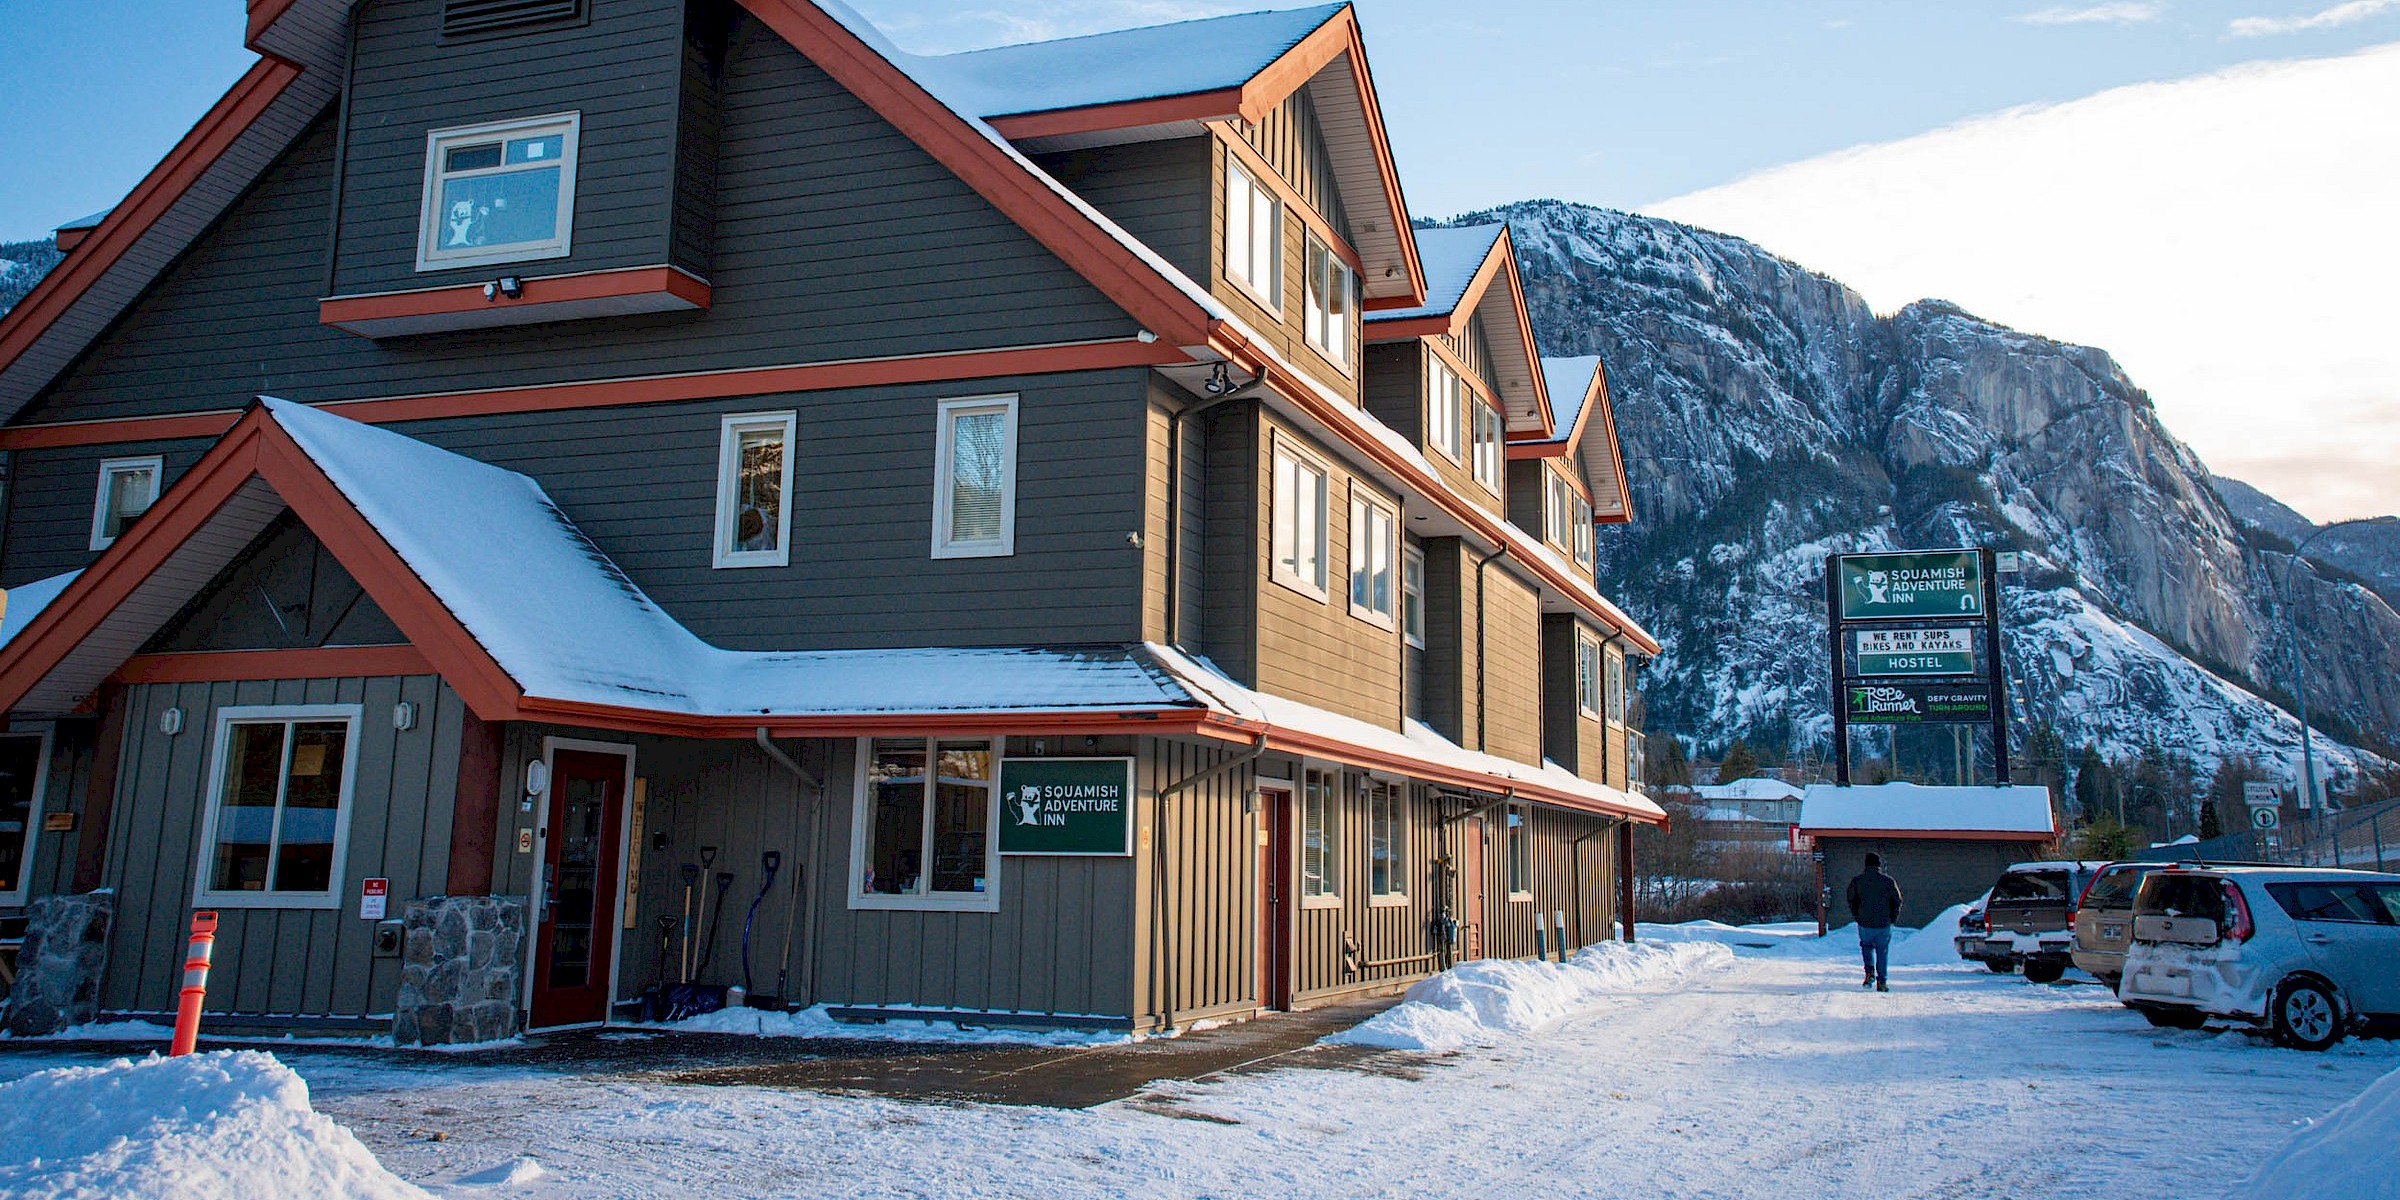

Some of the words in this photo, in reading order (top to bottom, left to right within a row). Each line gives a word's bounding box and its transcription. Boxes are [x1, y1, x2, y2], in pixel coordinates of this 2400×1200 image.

[1891, 568, 1965, 580] SQUAMISH
[1892, 579, 1966, 591] ADVENTURE
[1892, 593, 1914, 604] INN
[1873, 632, 1887, 641] WE
[1893, 631, 1918, 640] RENT
[1923, 631, 1950, 640] SUPS
[1863, 642, 1891, 651] BIKES
[1896, 642, 1915, 650] AND
[1921, 641, 1962, 650] KAYAKS
[1889, 658, 1942, 668] HOSTEL
[1951, 694, 1988, 702] GRAVITY
[1928, 704, 1951, 712] TURN
[1952, 703, 1988, 711] AROUND
[1044, 785, 1119, 799] SQUAMISH
[1044, 799, 1118, 812] ADVENTURE
[1043, 813, 1066, 826] INN
